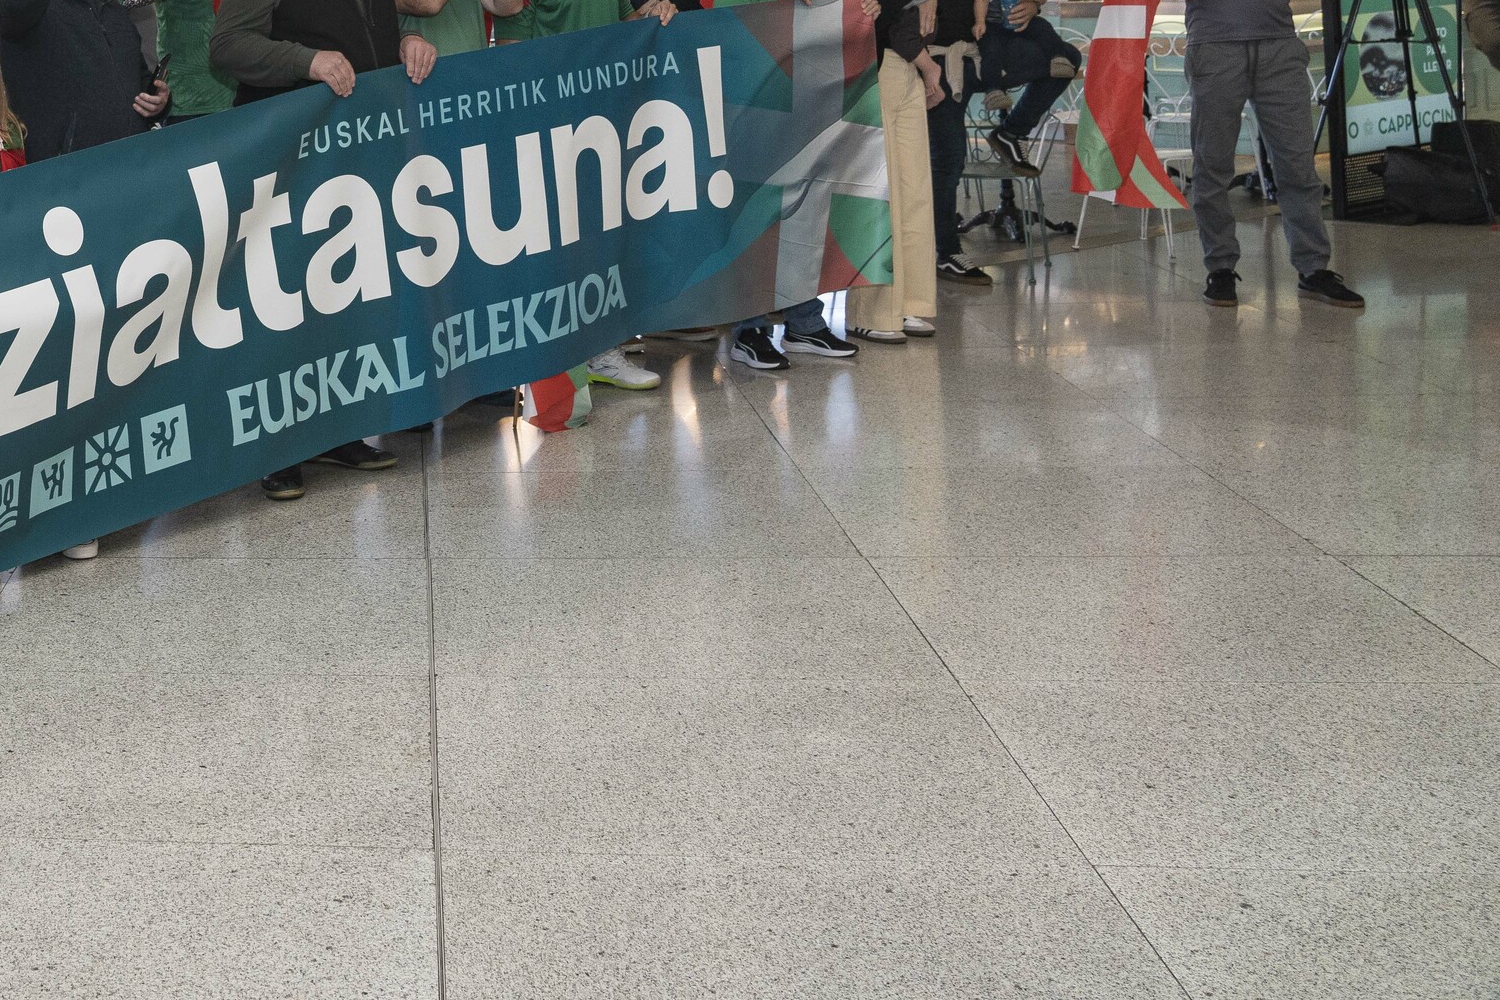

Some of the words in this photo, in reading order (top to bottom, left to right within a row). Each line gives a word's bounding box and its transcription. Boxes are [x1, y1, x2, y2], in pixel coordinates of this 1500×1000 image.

[298, 108, 410, 160] EUSKAL
[419, 78, 547, 129] HERRITIK
[557, 51, 680, 97] MUNDURA
[226, 336, 426, 447] EUSKAL
[432, 263, 628, 379] SELEKZIOA
